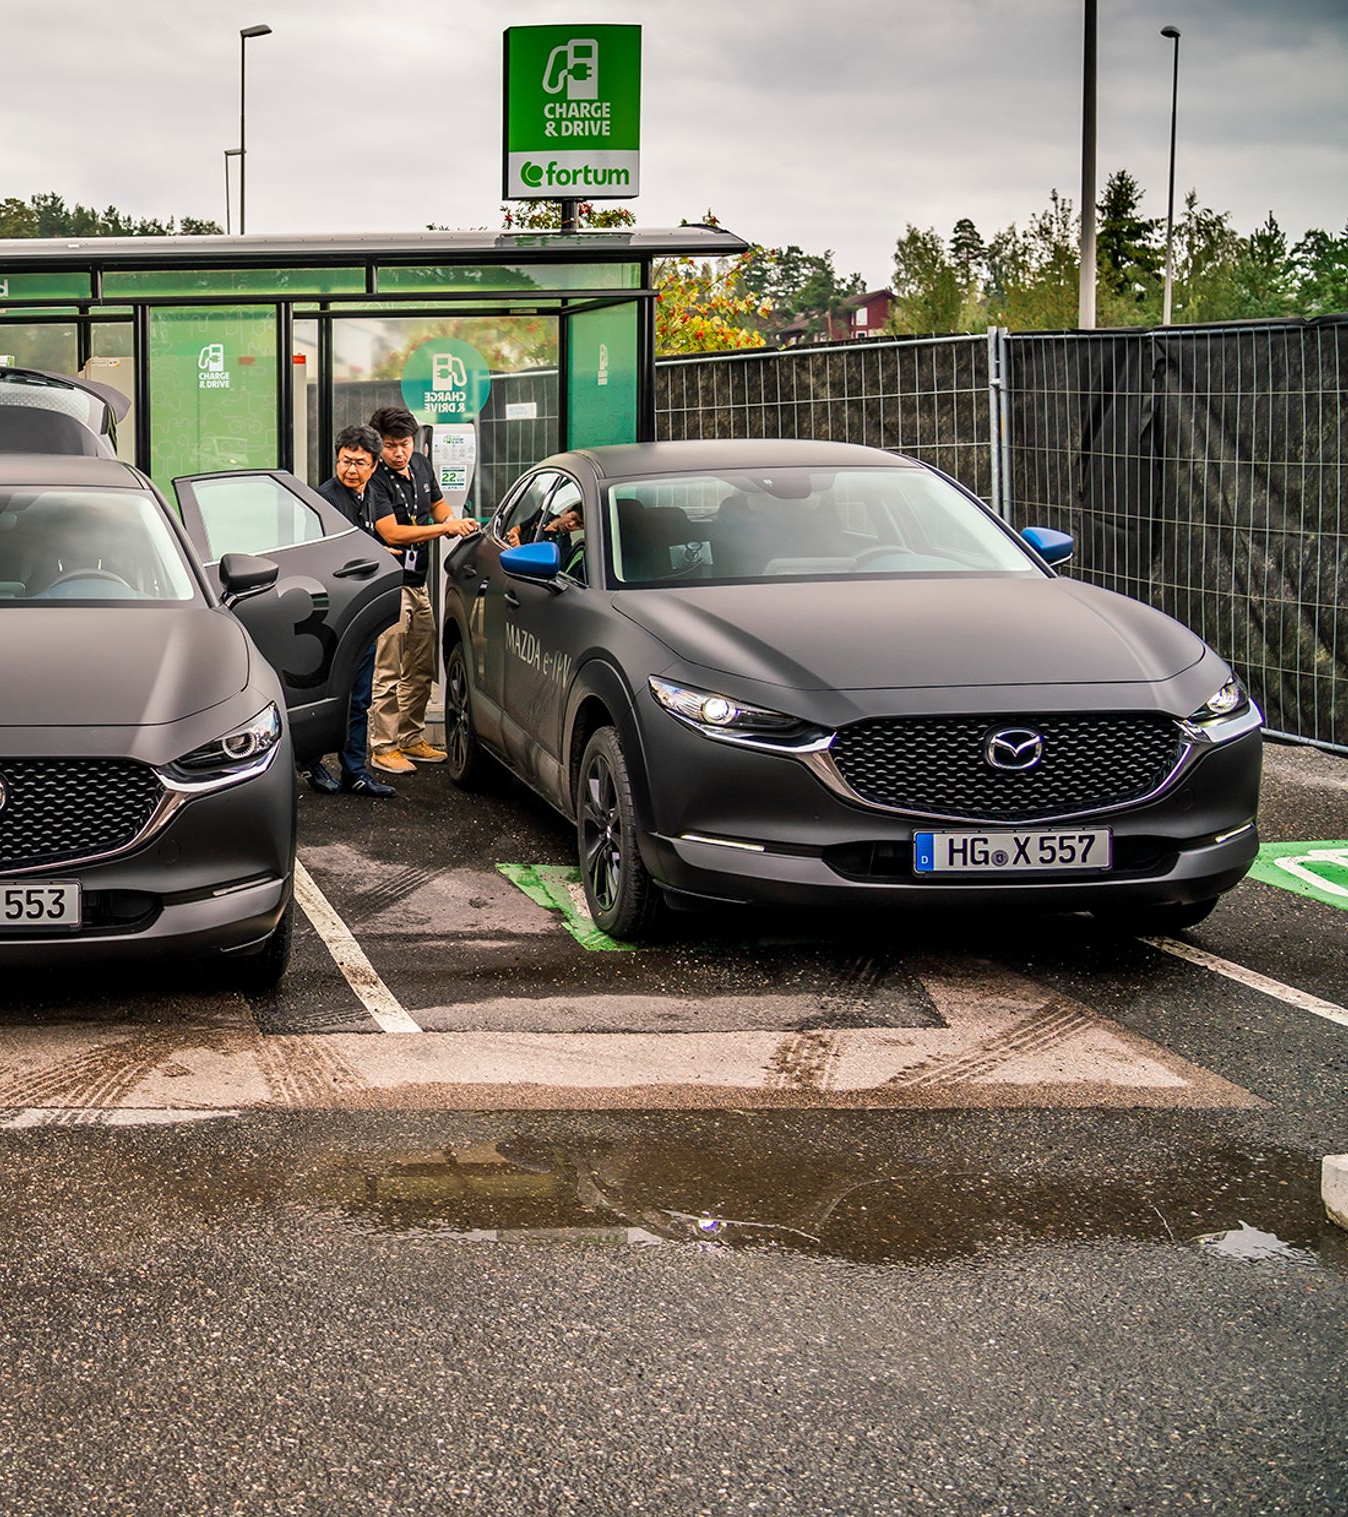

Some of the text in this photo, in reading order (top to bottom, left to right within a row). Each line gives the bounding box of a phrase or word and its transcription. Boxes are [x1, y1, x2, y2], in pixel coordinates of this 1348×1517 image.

[543, 102, 611, 119] CHARGE
[544, 120, 611, 137] & DRIVE
[545, 161, 630, 186] fortum
[198, 372, 230, 380] CHARGE
[199, 380, 230, 389] & DRIVE
[442, 473, 456, 482] 22
[275, 575, 339, 690] 3
[505, 621, 541, 671] MAZDA
[921, 834, 1096, 866] D HG X 557
[4, 889, 65, 920] 553
